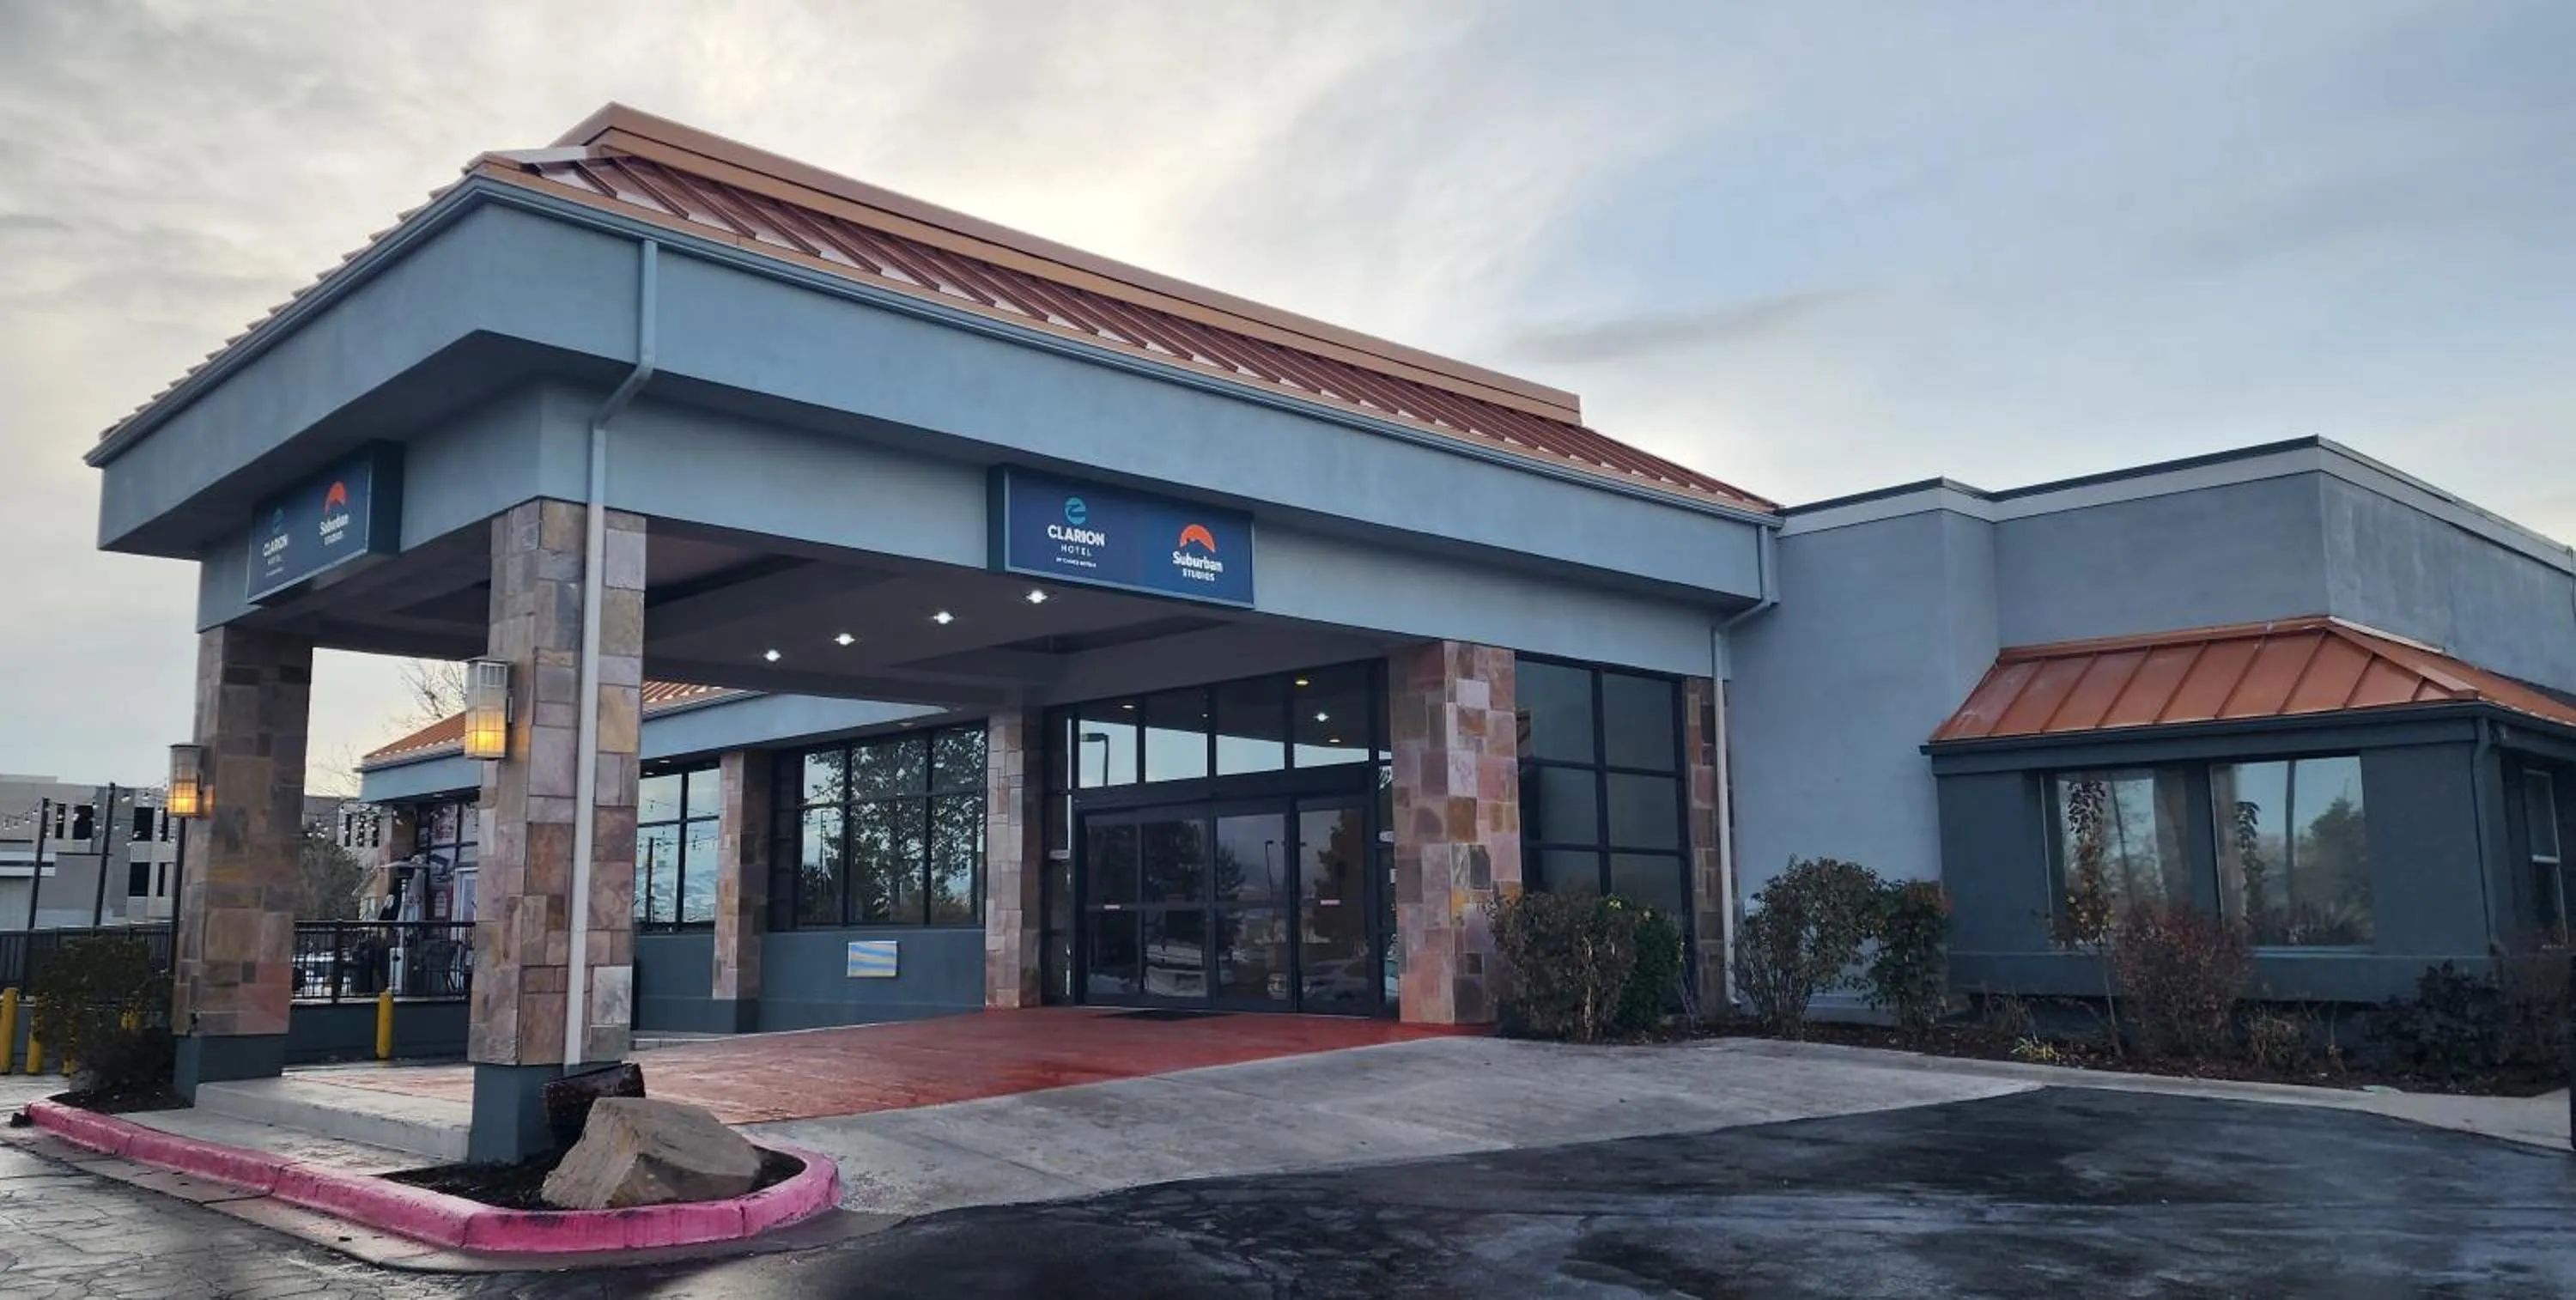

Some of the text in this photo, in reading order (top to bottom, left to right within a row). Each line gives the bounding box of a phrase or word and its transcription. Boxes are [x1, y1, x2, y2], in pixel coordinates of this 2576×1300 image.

[1048, 525, 1105, 547] CLARION
[1060, 544, 1092, 557] HOTEL
[1172, 550, 1224, 573] Suburban
